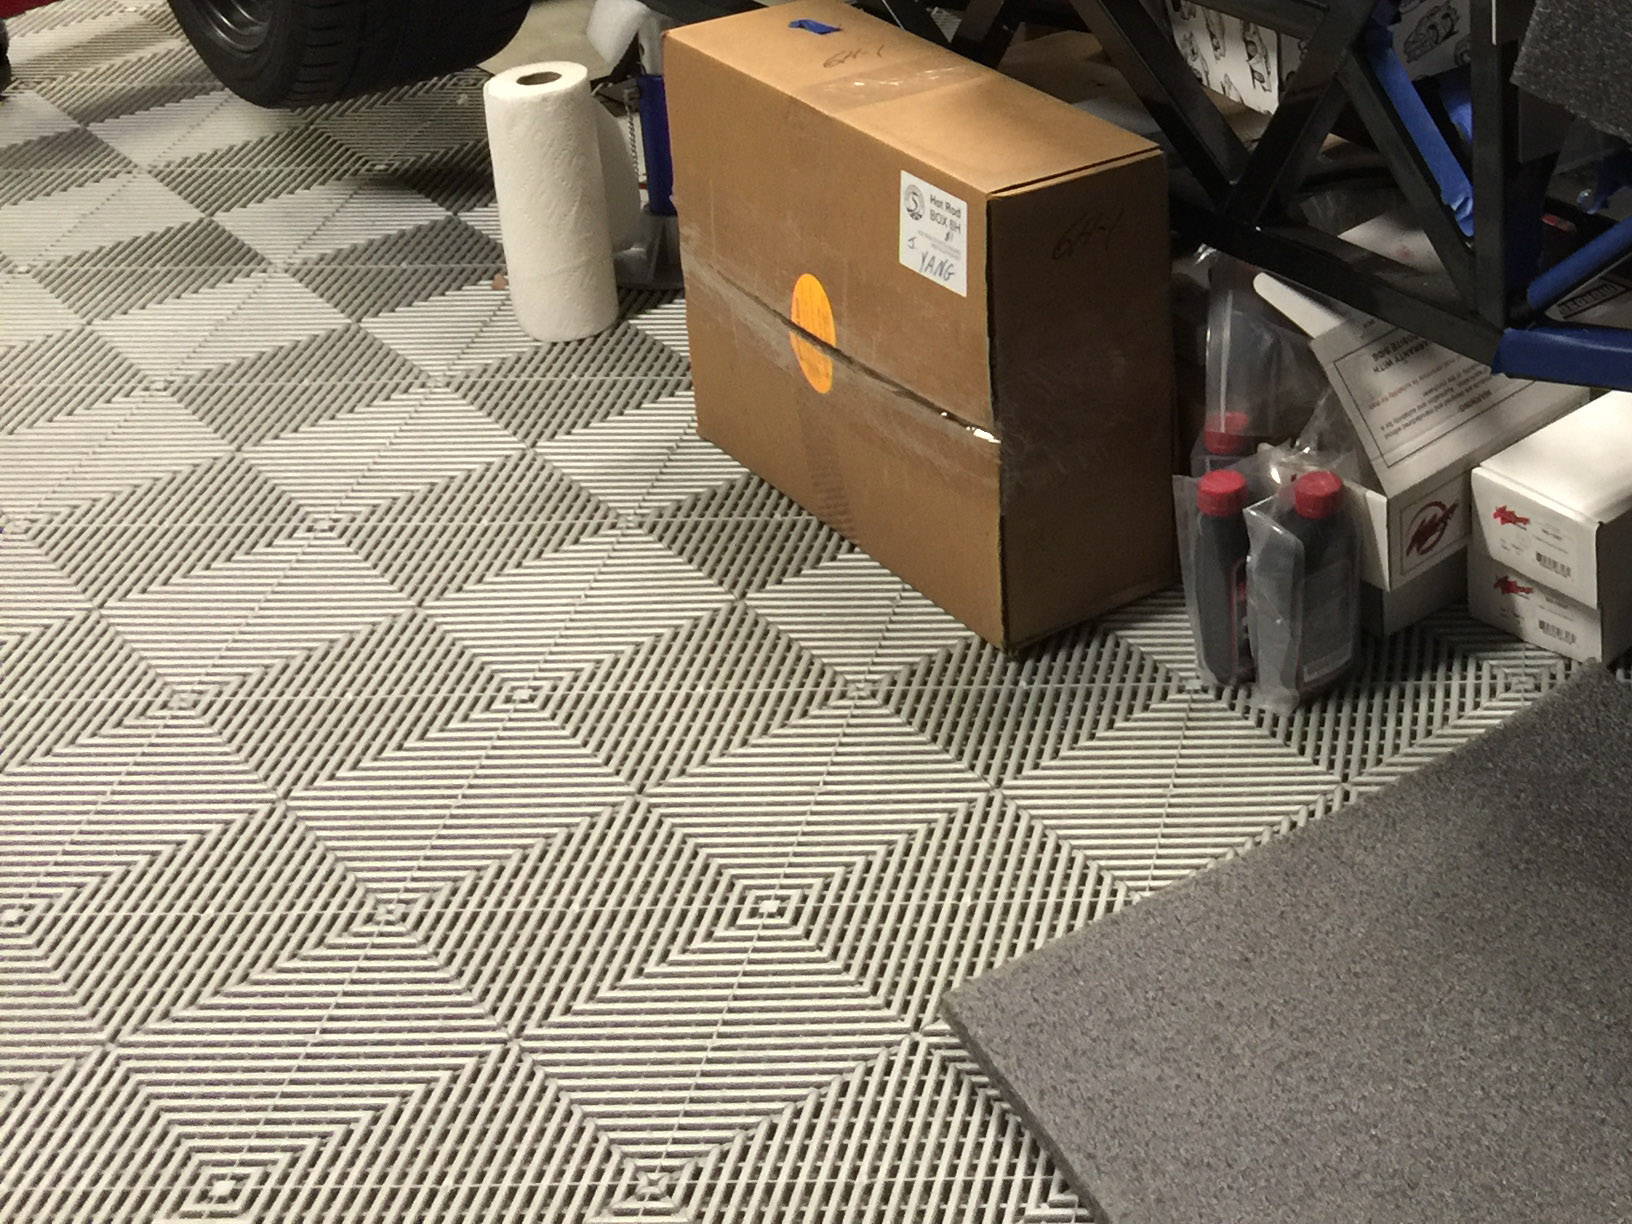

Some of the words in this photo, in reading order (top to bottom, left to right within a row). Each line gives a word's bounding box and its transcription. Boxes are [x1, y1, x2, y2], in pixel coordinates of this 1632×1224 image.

[929, 194, 943, 210] Hot
[945, 201, 961, 219] Rod
[929, 209, 948, 228] BOX
[919, 250, 956, 282] YANG
